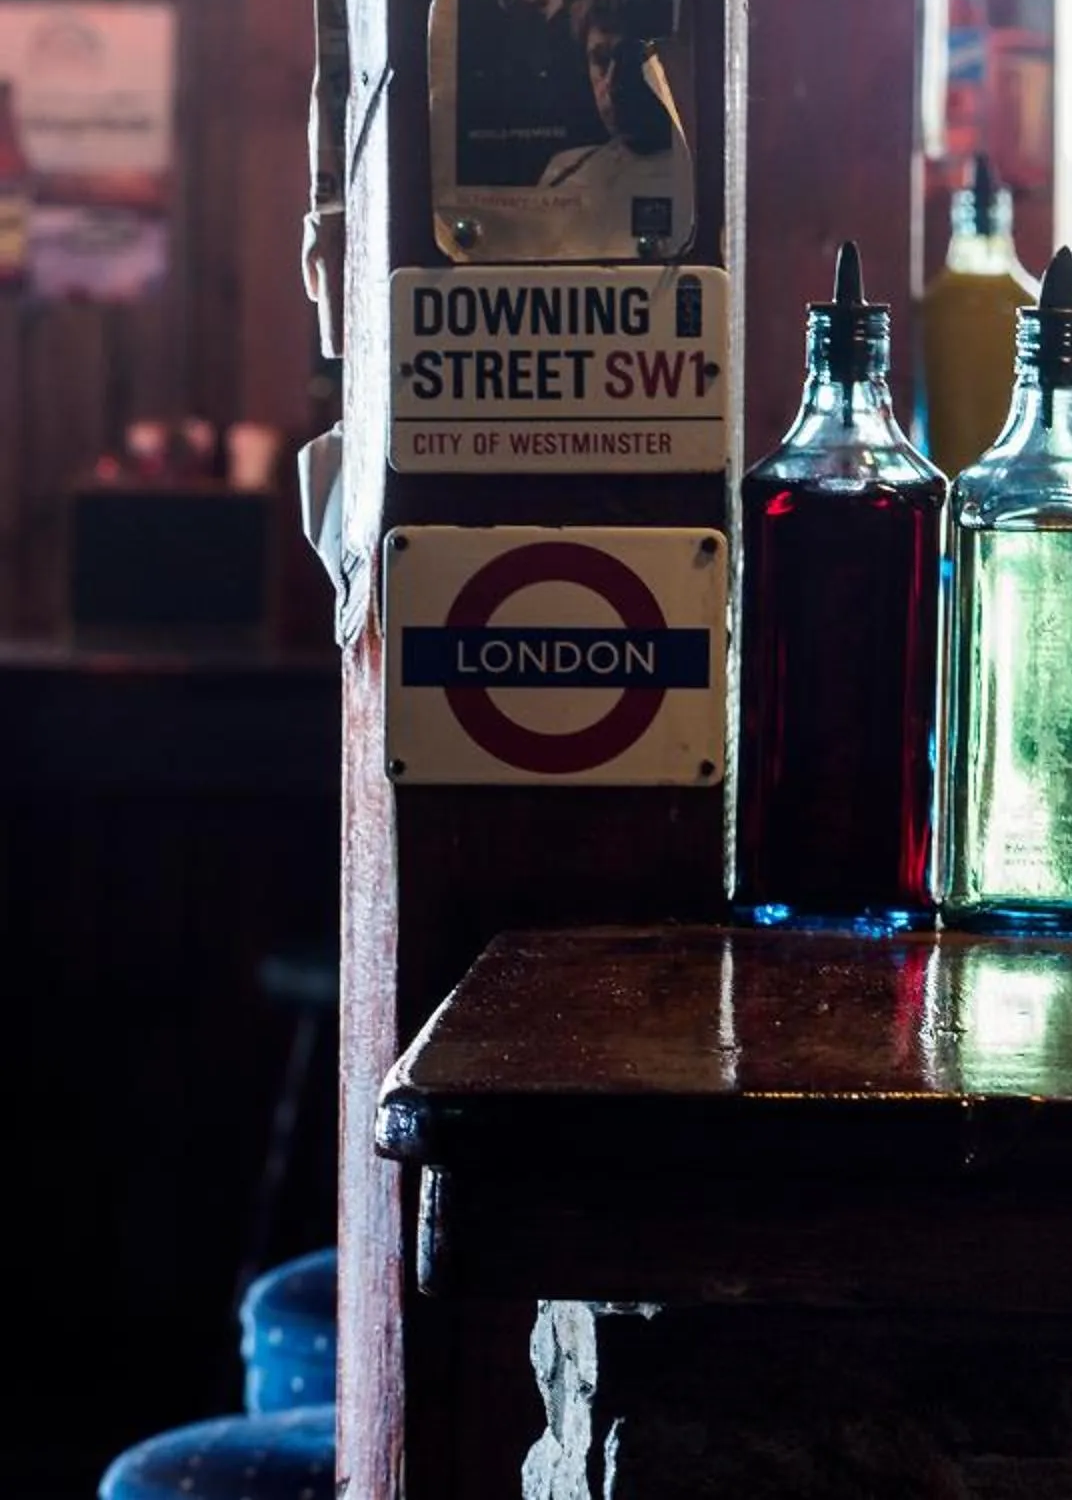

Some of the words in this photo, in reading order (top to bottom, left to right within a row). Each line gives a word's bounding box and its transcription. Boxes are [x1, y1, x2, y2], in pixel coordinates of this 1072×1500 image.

[413, 286, 650, 337] DOWNING
[412, 350, 595, 400] STREET
[605, 350, 705, 399] SW1
[413, 432, 462, 455] CITY
[473, 432, 500, 455] OF
[510, 433, 672, 455] WESTMINSTER
[456, 640, 655, 674] LONDON
